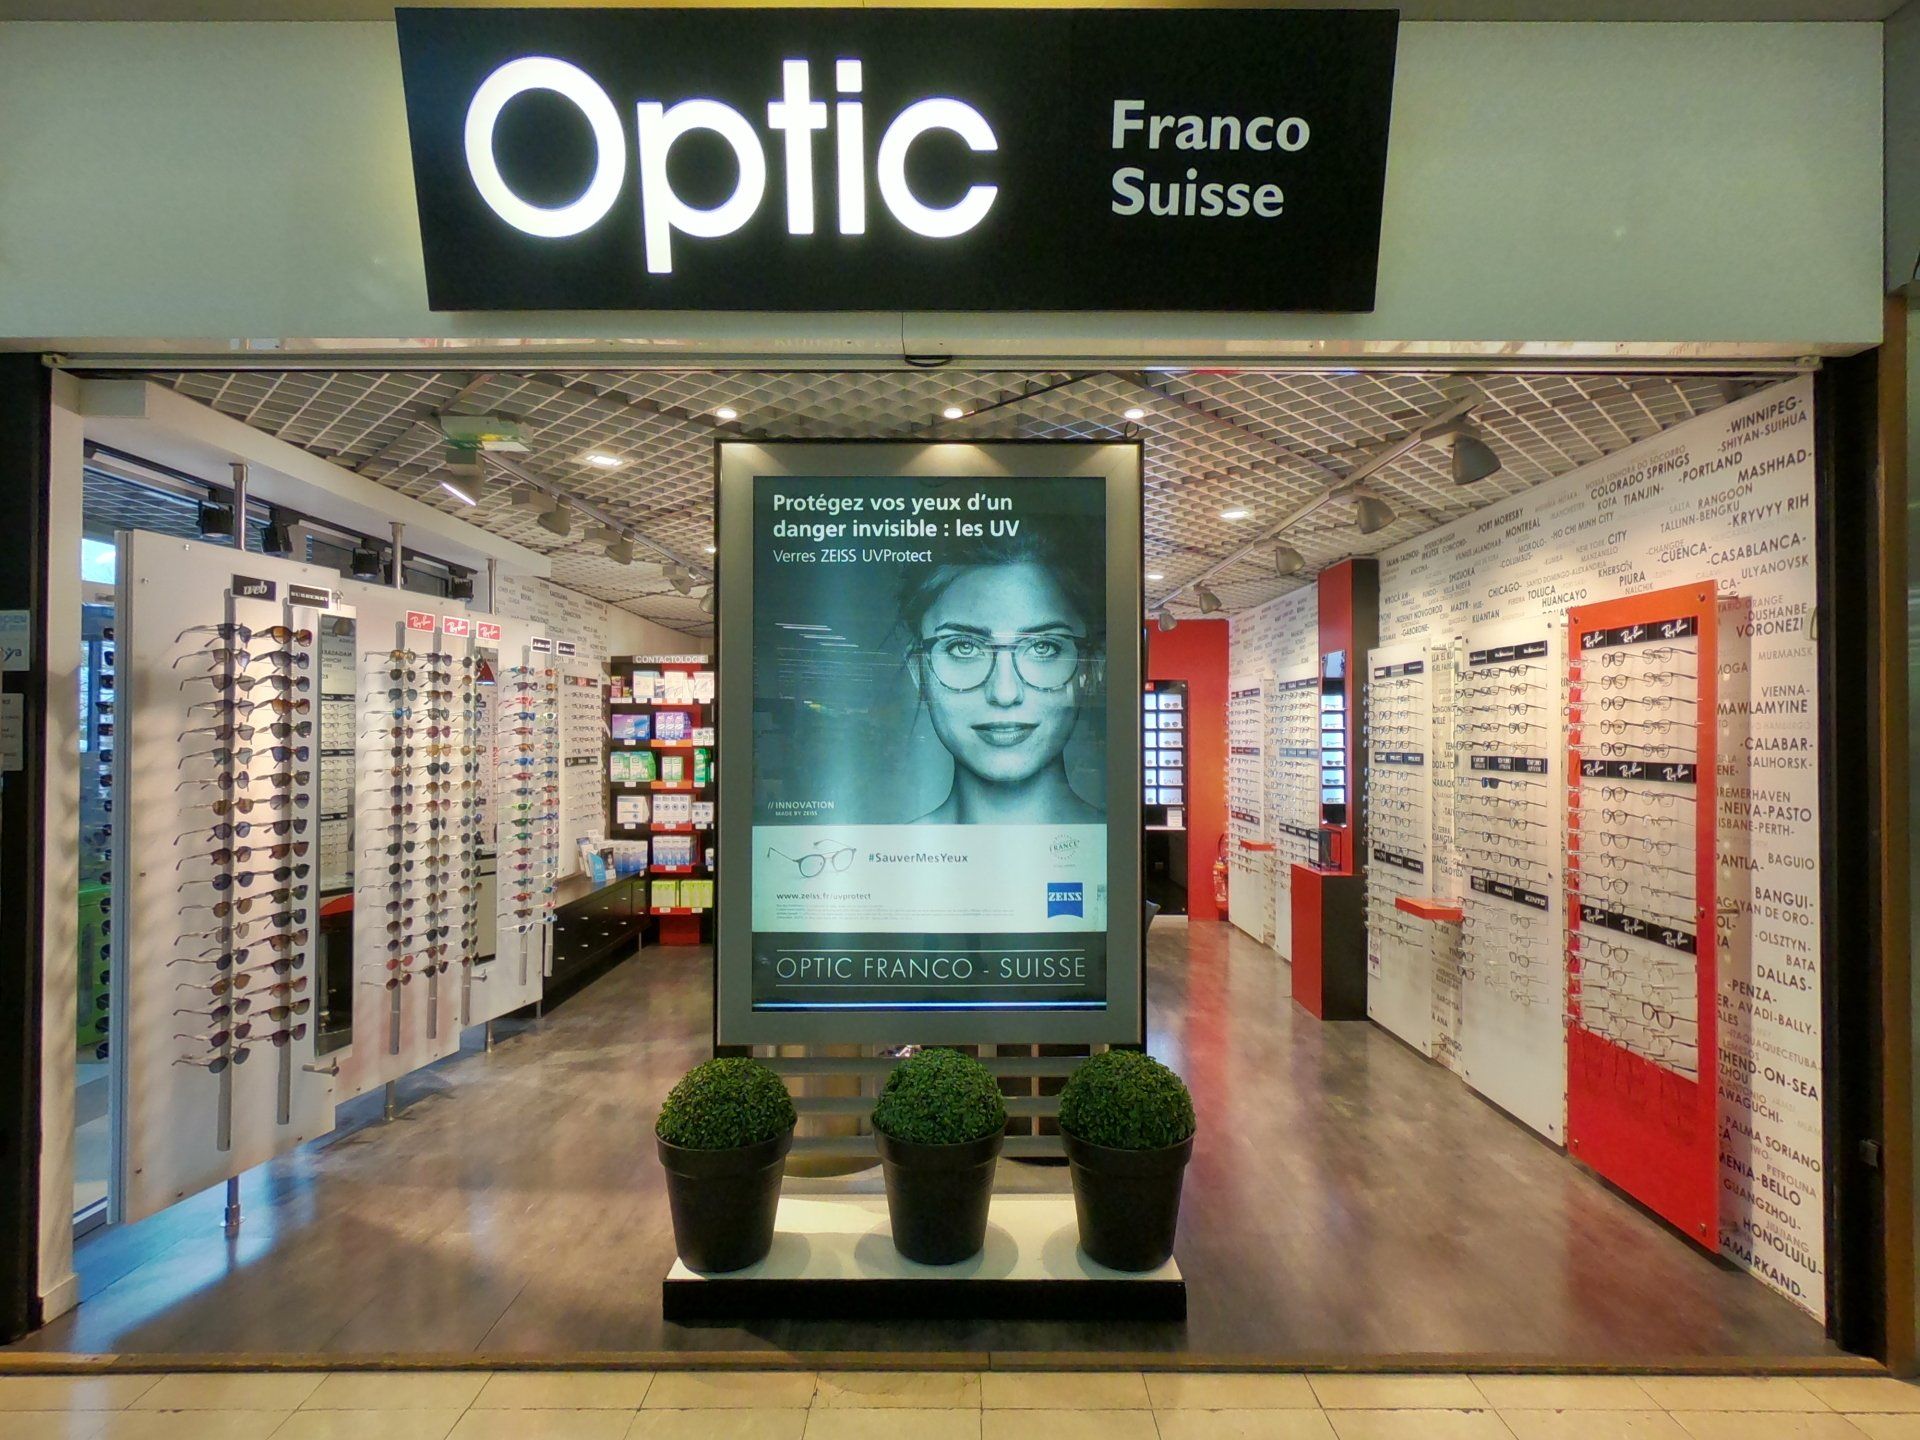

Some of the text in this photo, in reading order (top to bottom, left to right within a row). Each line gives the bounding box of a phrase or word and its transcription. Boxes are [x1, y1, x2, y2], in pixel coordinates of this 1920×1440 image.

[1111, 99, 1311, 151] Franco
[464, 56, 999, 274] Optic
[1111, 166, 1285, 217] Suisse
[1726, 396, 1802, 433] -WINNIPEG-
[1717, 411, 1807, 452] -SHIYAN-SUIHUA
[1590, 452, 1690, 500] COLORADO SPRINGS
[1678, 451, 1743, 483] -PORTLAND
[1737, 449, 1812, 483] MASHHAD-
[773, 493, 864, 515] Protégez
[870, 498, 905, 511] vos
[911, 498, 961, 515] yeux
[1597, 496, 1618, 512] KOTA
[1623, 483, 1664, 507] TIANJIN-
[1697, 482, 1753, 511] RANGOON
[1494, 507, 1524, 527] MORESBY
[1660, 500, 1740, 533] TALLINN-BENGKU
[1727, 500, 1783, 528] -KRYVYY
[1787, 494, 1809, 512] RIH
[773, 519, 847, 542] danger
[853, 519, 938, 537] invisible
[956, 519, 983, 537] les
[990, 520, 1020, 537] UV
[1505, 517, 1541, 539] MONTREAL
[1564, 524, 1577, 536] CHI
[1577, 517, 1597, 532] MINH
[1598, 512, 1615, 525] CITY
[1607, 530, 1627, 545] CITY
[773, 549, 932, 563] Verres ZEISS UVProtect
[1657, 542, 1712, 563] -CUENCA-
[1706, 533, 1806, 566] -CASABLANCA-
[1598, 561, 1633, 578] KHERSON
[1741, 554, 1809, 579] ULYANOVSK
[243, 581, 268, 596] web
[1619, 571, 1646, 586] PIURA
[1488, 581, 1522, 599] CHICAGO-
[1528, 585, 1556, 600] TOLUCA
[1542, 588, 1588, 608] HUANCAYO
[1744, 602, 1808, 621] -DUSHANBE
[1745, 594, 1784, 609] ORANGE
[1472, 609, 1500, 624] KUANTAN
[635, 655, 706, 664] CONTACTOLOGIE
[1758, 647, 1814, 660] MURMANSK
[1761, 684, 1810, 697] VIENNA-
[1717, 700, 1808, 715] MAWLAMYINE
[1740, 737, 1814, 751] -CALABAR-
[1747, 755, 1812, 769] SALIHORSK-
[1719, 801, 1812, 822] -NEIVA-PASTO
[868, 852, 968, 863] #SauverMesYeux
[1768, 852, 1815, 870] BAGUIO
[1048, 892, 1082, 901] ZEISS
[1755, 886, 1814, 909] BANGUI-
[1765, 906, 1779, 919] DE
[1782, 909, 1814, 926] ORO-
[1754, 930, 1812, 953] -OLSZTYN-
[776, 957, 1086, 979] OPTIC FRANCO SUISSE
[1786, 954, 1816, 973] BATA
[1756, 964, 1812, 992] DALLAS-
[1727, 979, 1778, 1004] -PENZA-
[1738, 1001, 1817, 1036] AVADI-BALLY-
[1719, 1064, 1749, 1085] ZHOU
[1725, 1115, 1821, 1173] PALMA SORIANO
[1766, 1163, 1817, 1199] PETROLINA
[1723, 1178, 1801, 1231] GUANGZHOU-
[1743, 1216, 1823, 1276] HONOLULU-
[1718, 1230, 1807, 1300] SAMARKAND-
